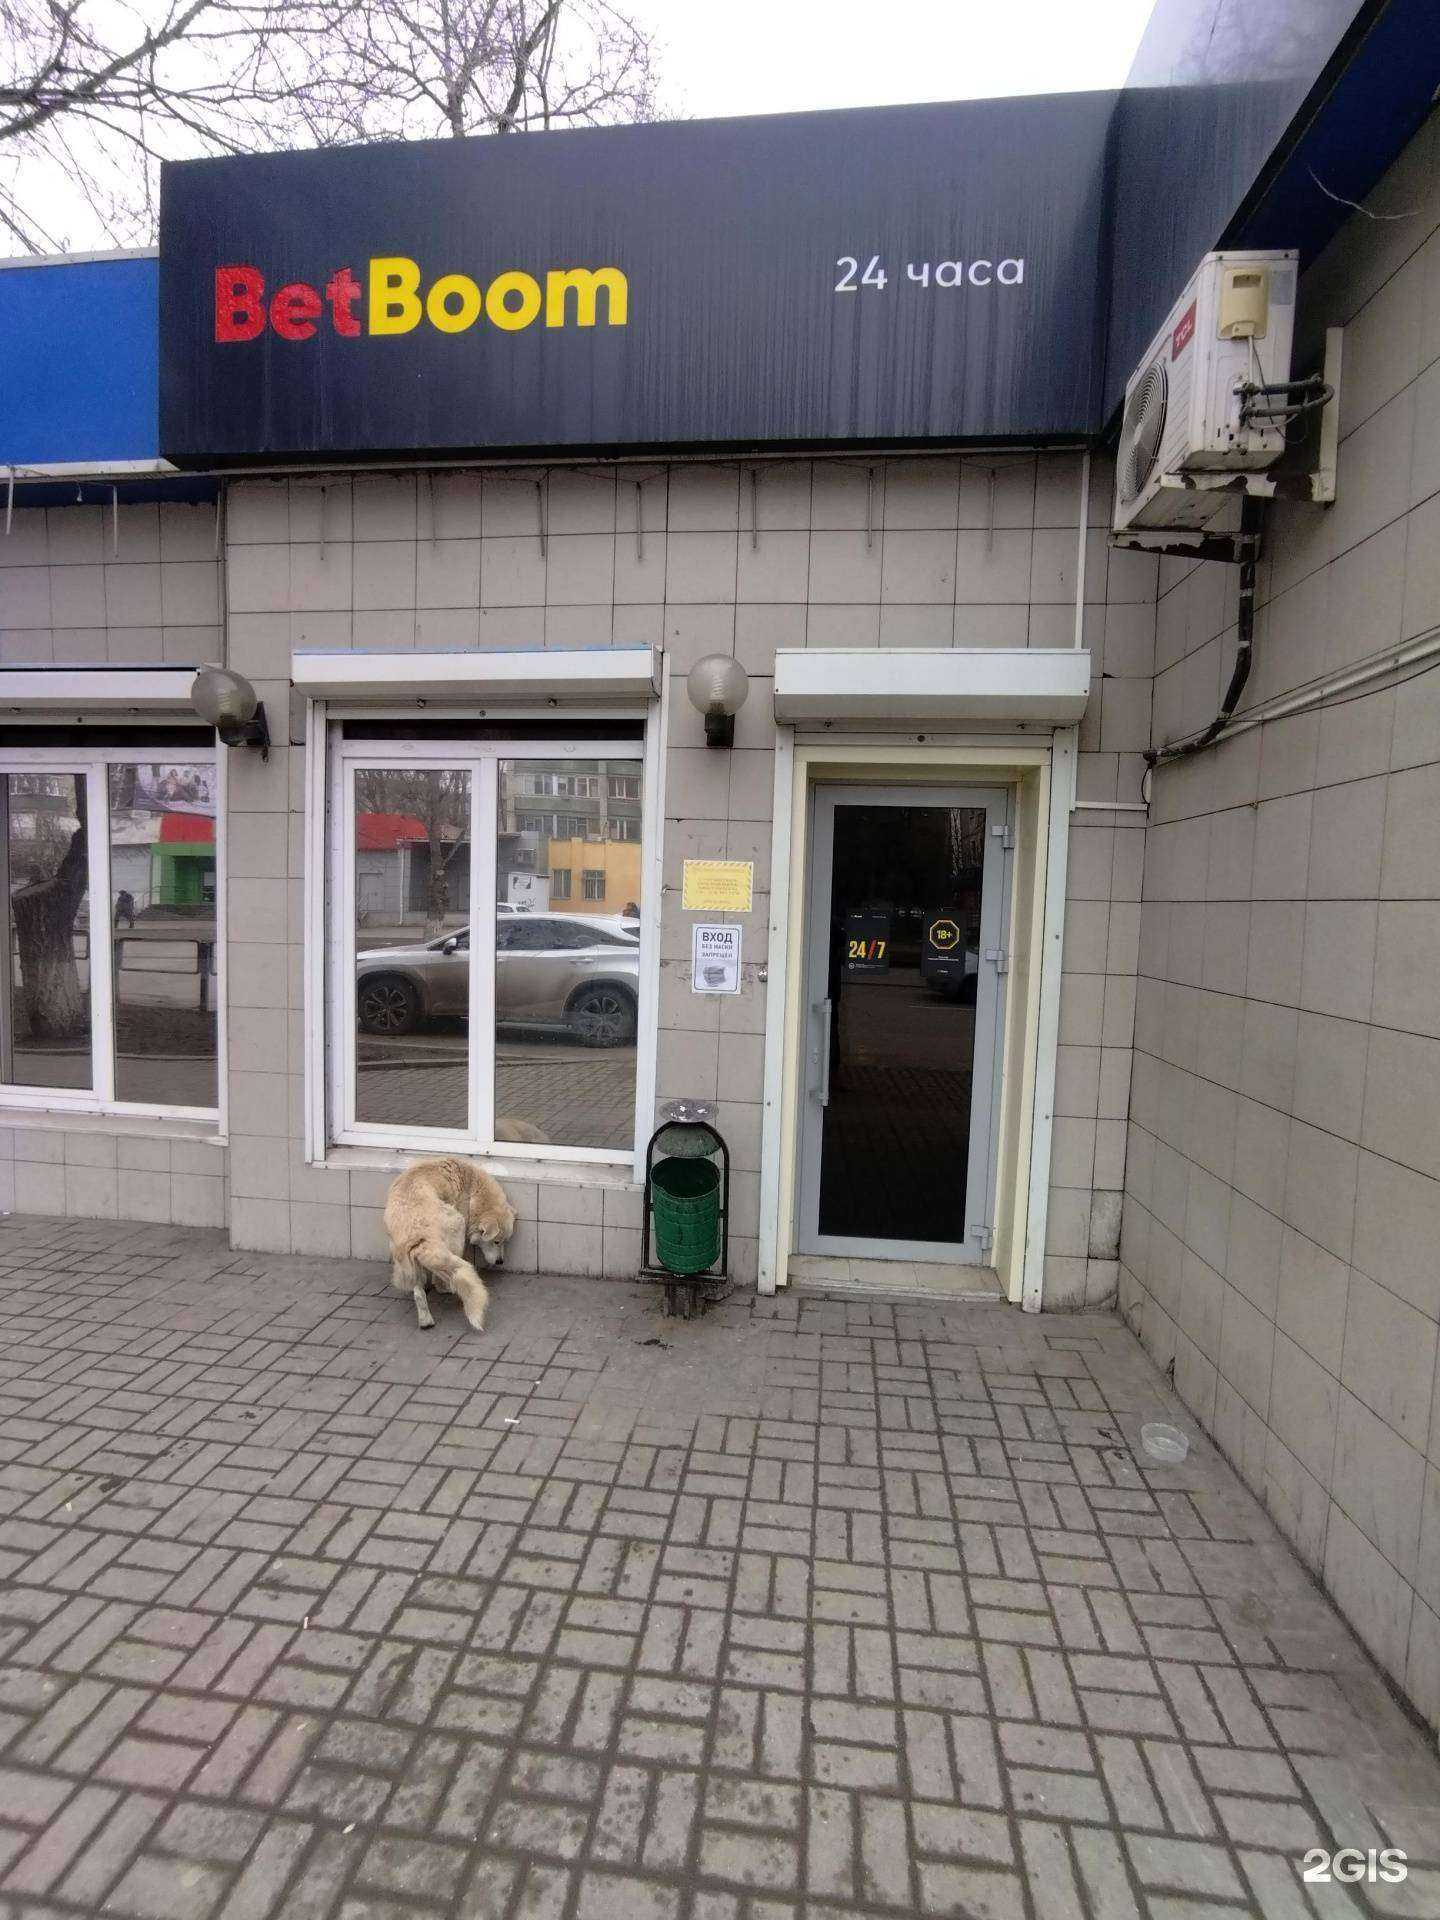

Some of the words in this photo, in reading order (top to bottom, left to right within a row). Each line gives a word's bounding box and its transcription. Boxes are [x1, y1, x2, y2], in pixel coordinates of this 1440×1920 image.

[834, 256, 888, 291] 24
[906, 257, 1025, 288] часа
[215, 257, 627, 343] BetBoom
[1175, 320, 1192, 347] TCL
[702, 932, 733, 944] ВХОД
[936, 929, 951, 940] 18+
[848, 940, 886, 961] 24/7
